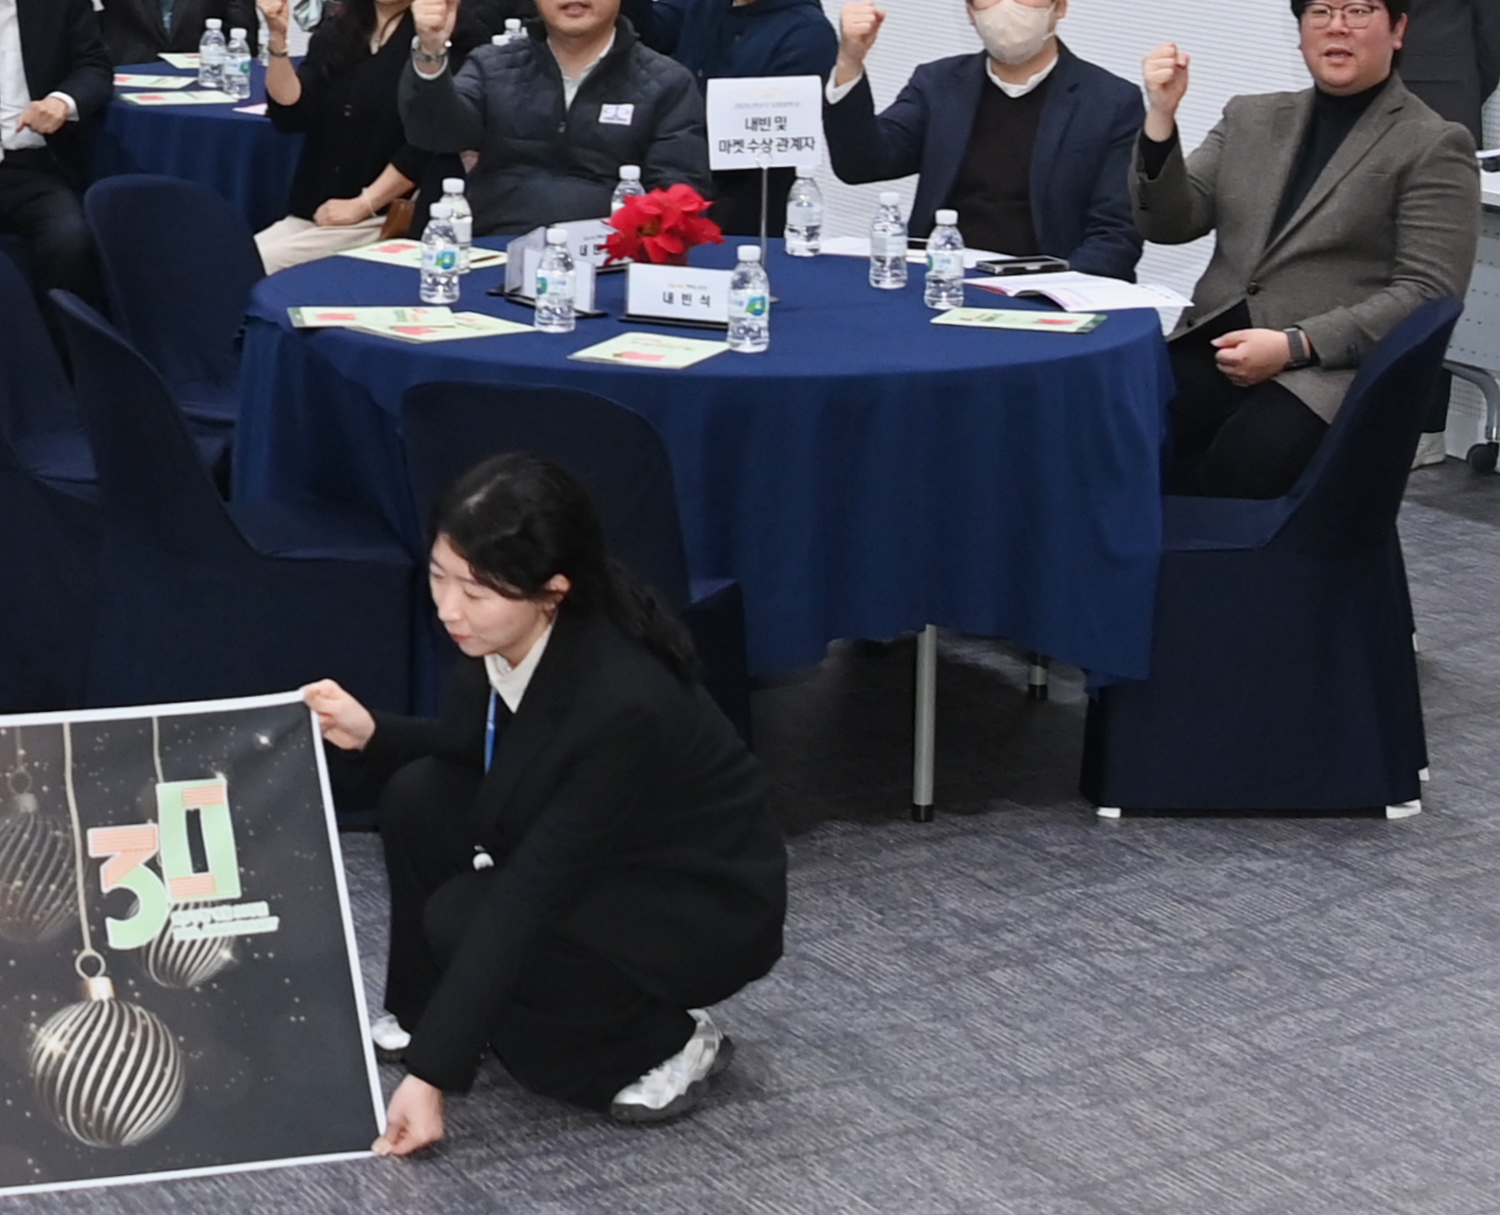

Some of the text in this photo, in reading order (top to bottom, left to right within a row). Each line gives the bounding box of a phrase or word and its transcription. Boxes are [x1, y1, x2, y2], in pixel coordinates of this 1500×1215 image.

[745, 116, 771, 132] 내빈
[718, 136, 815, 154] 마켓 수상 관계자
